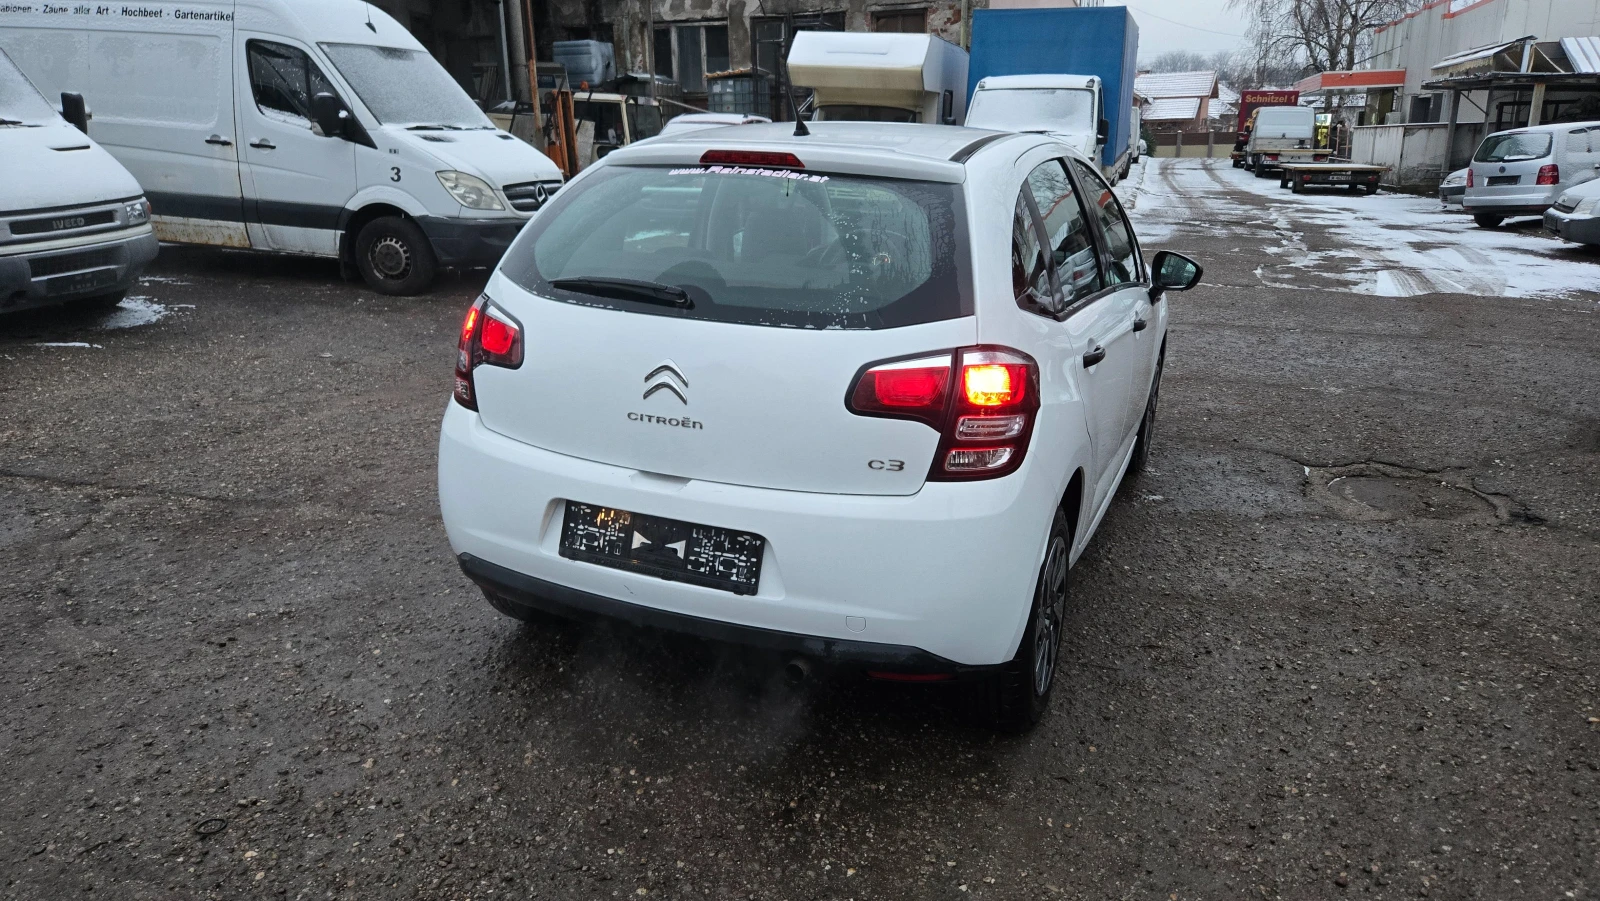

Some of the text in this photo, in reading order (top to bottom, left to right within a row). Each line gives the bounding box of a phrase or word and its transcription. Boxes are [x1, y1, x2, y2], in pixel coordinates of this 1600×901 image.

[95, 5, 109, 16] Art
[121, 6, 163, 19] Hochbeet
[174, 9, 235, 22] Gartenartikel
[1244, 94, 1296, 103] Schnitzel 1
[390, 166, 402, 183] 3
[52, 216, 85, 230] IVECO
[867, 459, 905, 472] C3
